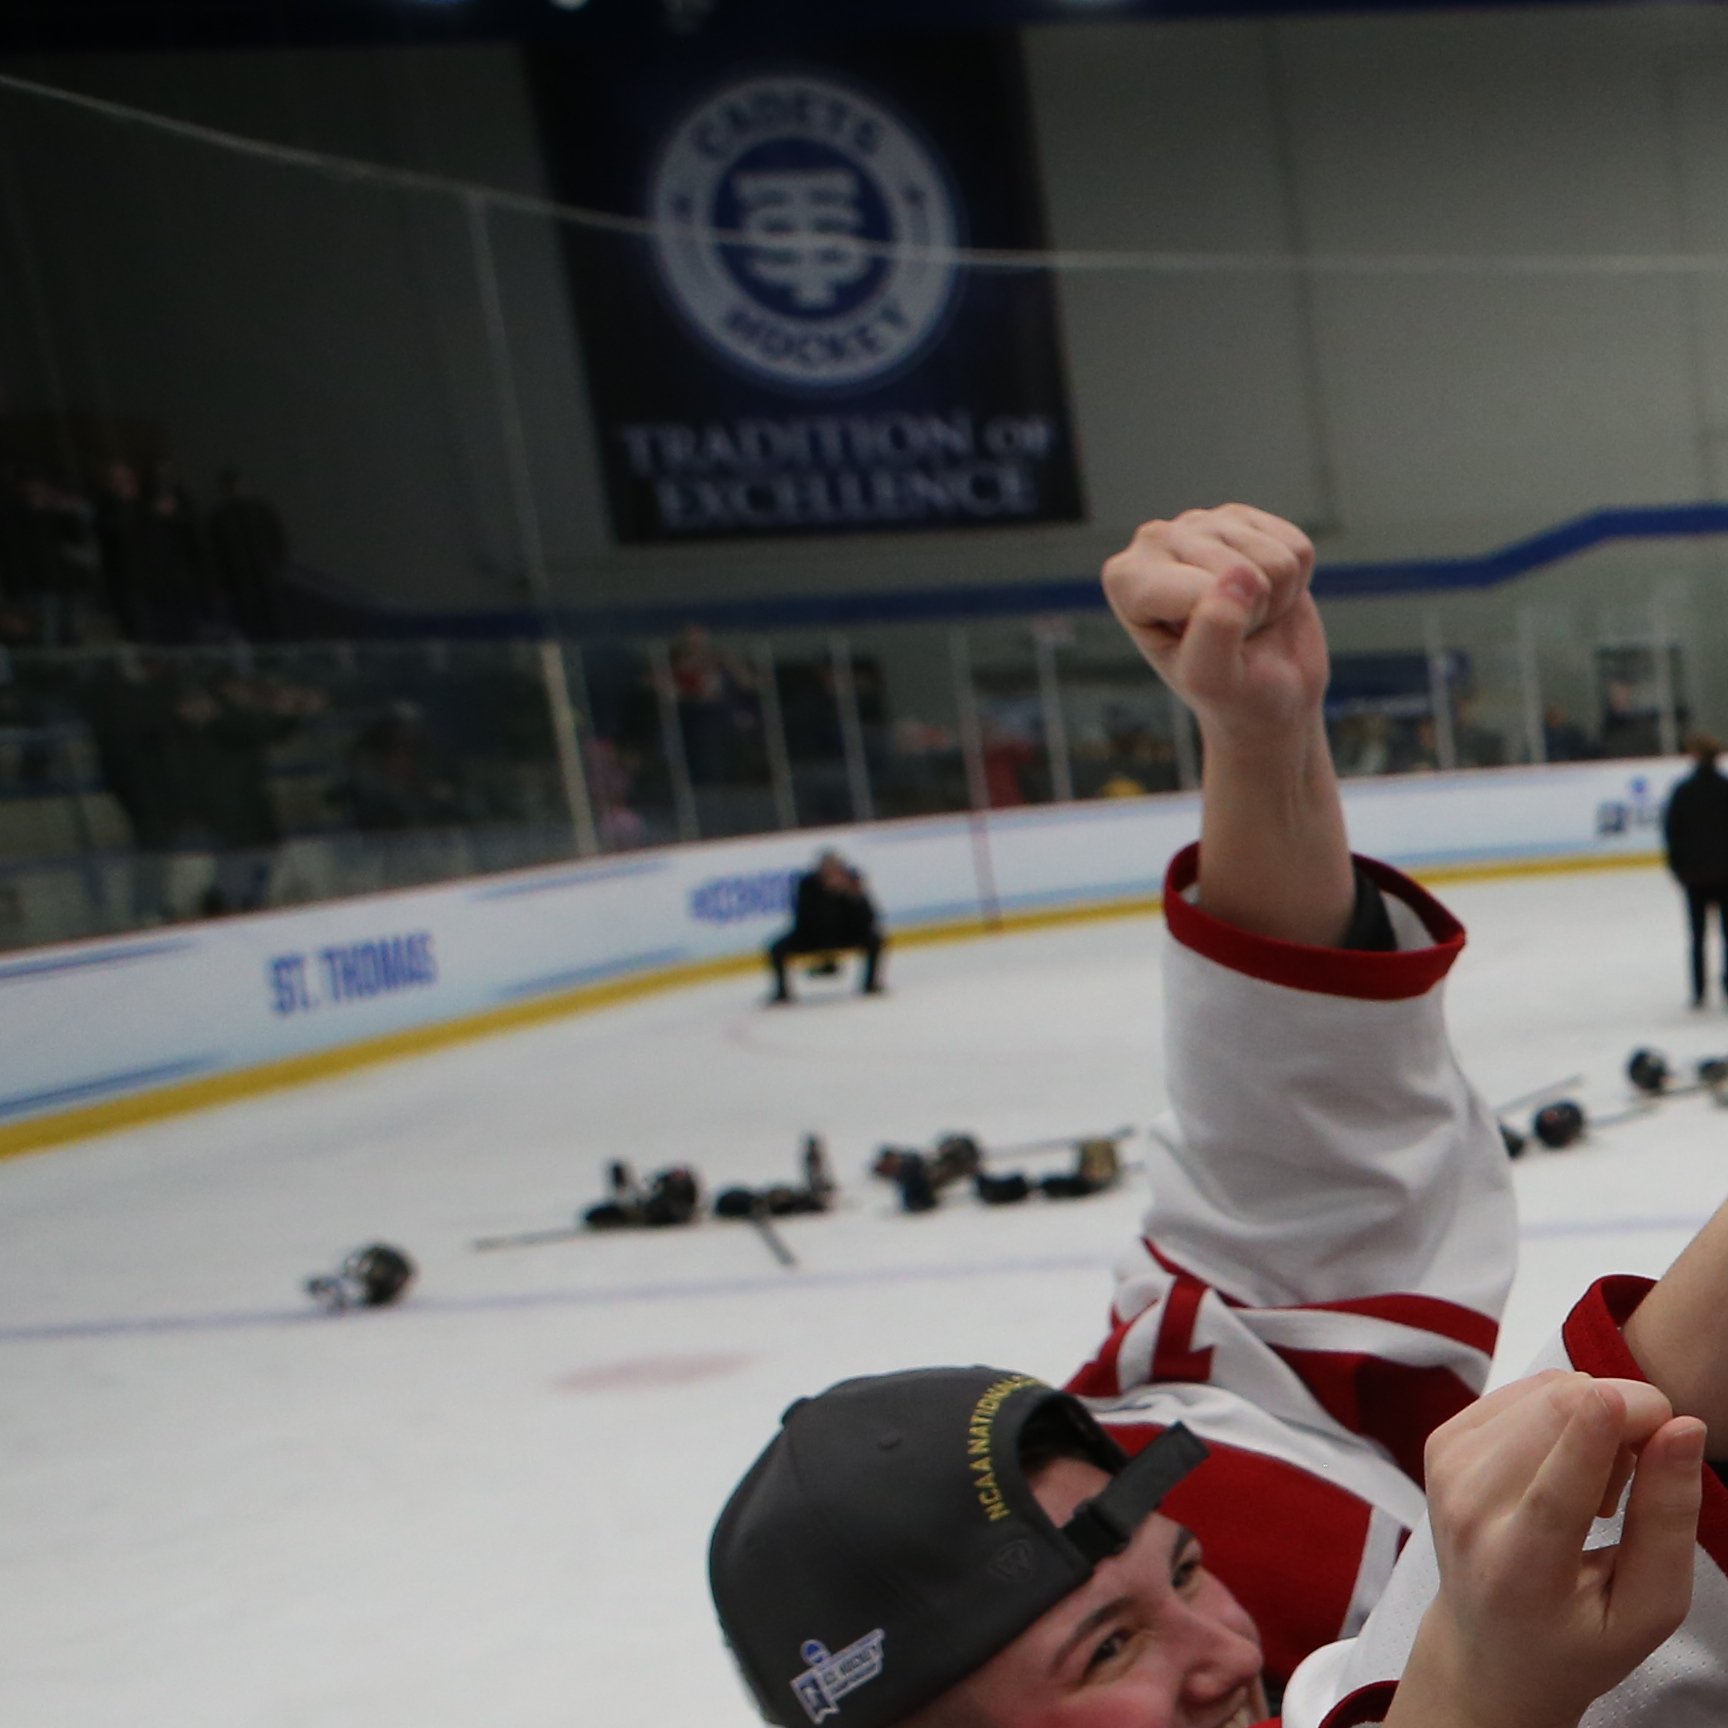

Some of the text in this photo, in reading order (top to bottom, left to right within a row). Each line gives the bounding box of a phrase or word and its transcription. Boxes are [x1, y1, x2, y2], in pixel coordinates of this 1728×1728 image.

[722, 306, 910, 365] HOCKEY
[619, 408, 1055, 476] TRADITION OF
[654, 461, 1040, 528] EXCELLENCE
[322, 930, 439, 998] THOMAS
[968, 1455, 1012, 1522] NCAA
